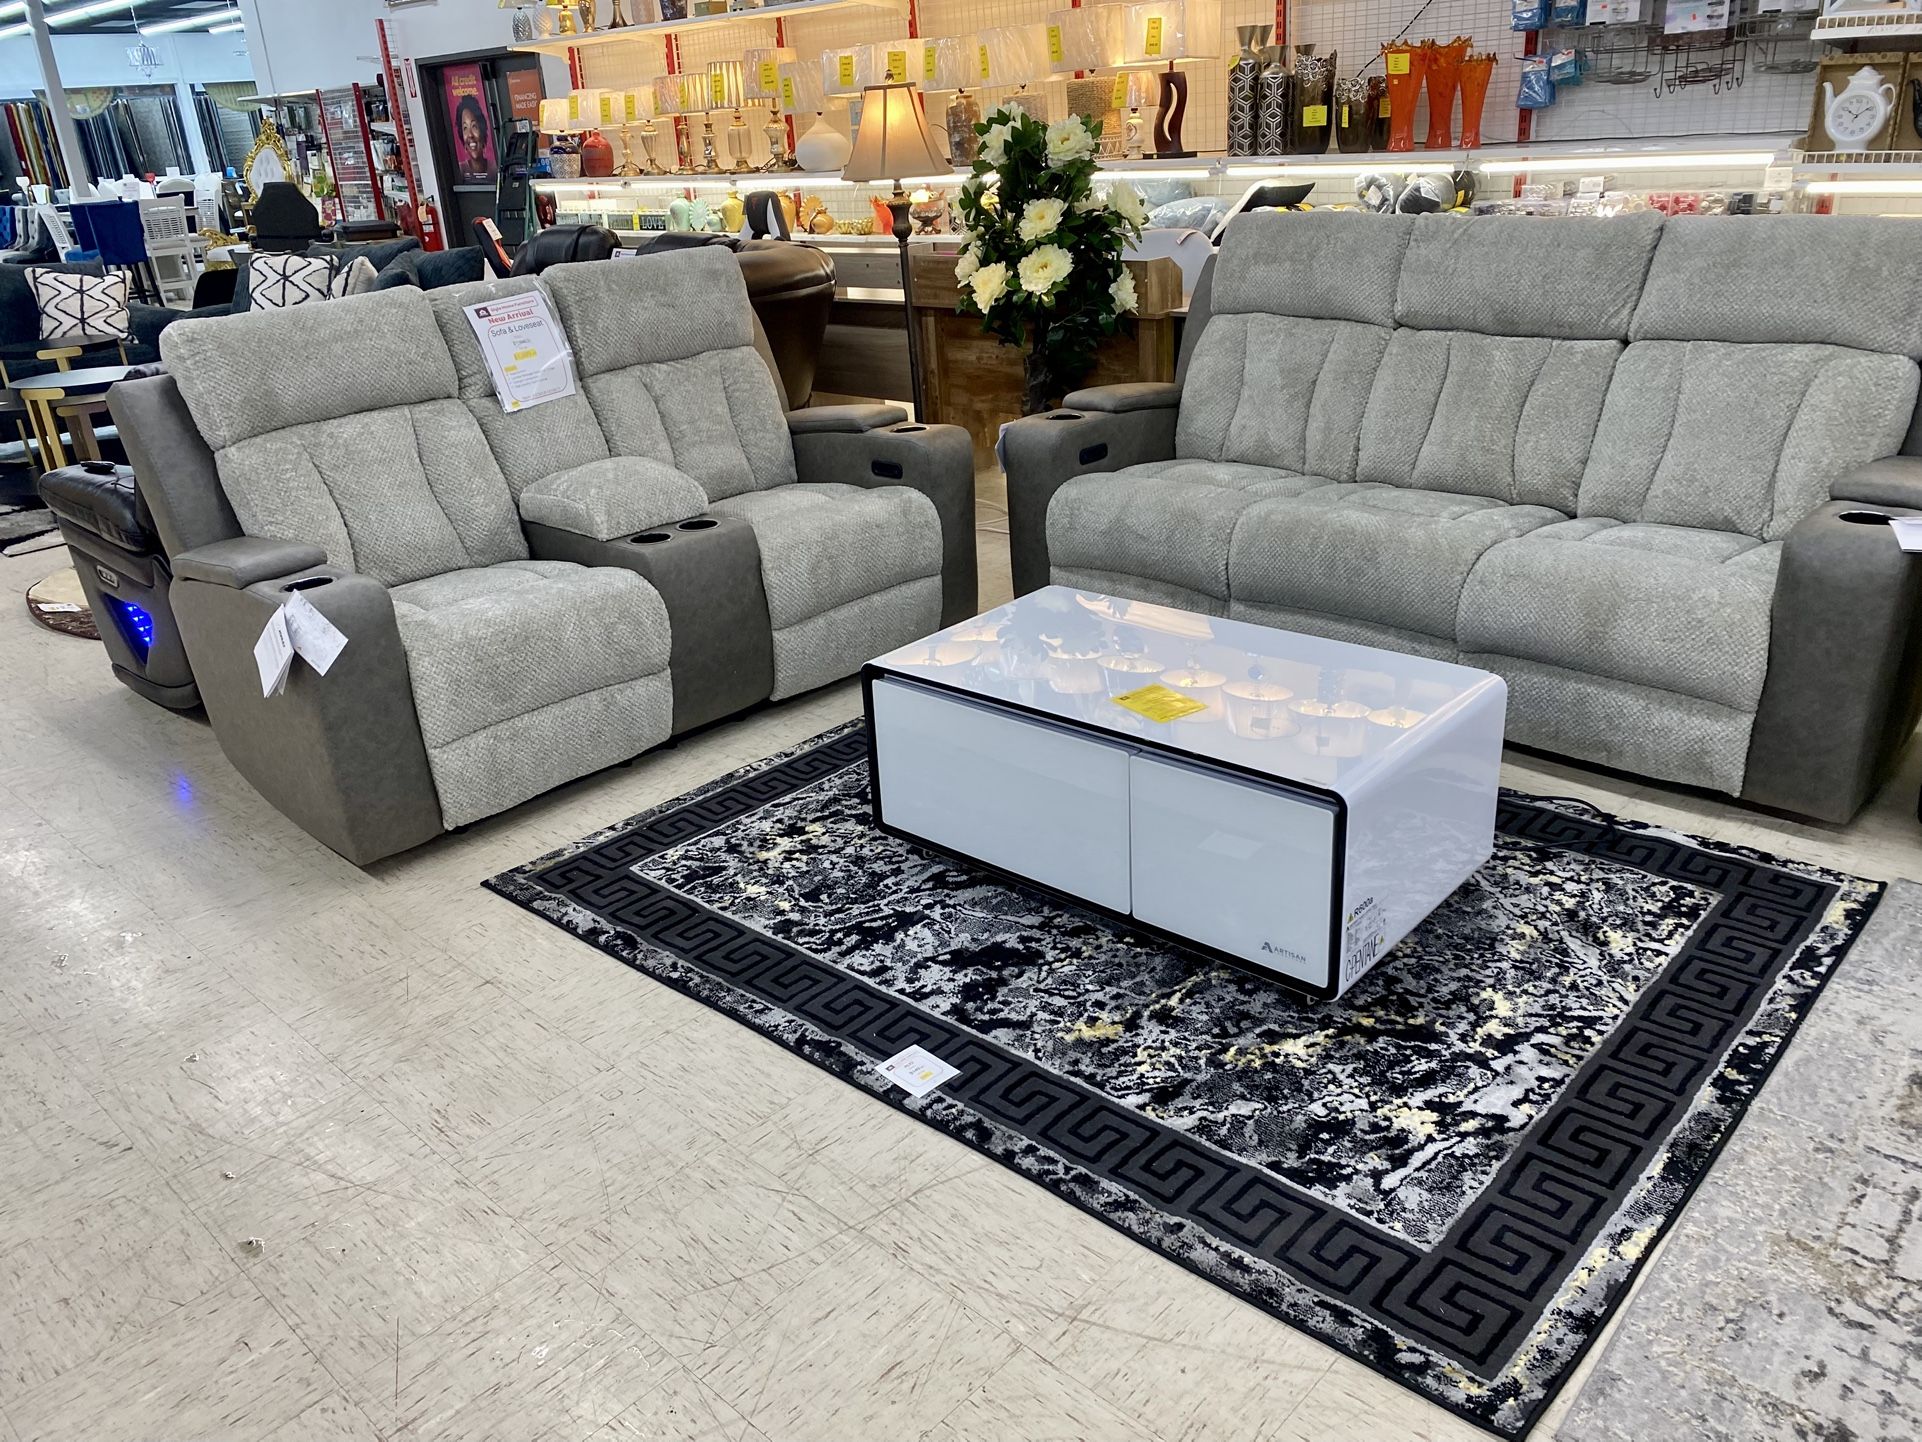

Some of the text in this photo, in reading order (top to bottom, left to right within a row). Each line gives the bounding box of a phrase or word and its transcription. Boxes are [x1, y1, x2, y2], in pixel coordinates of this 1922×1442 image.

[514, 92, 537, 100] FINANCING
[527, 100, 538, 108] EASY
[641, 216, 665, 230] LOVE
[488, 308, 534, 325] New Arrival
[491, 328, 508, 337] Sofa
[514, 320, 545, 332] Loveseat
[1274, 946, 1306, 963] ARTISAN
